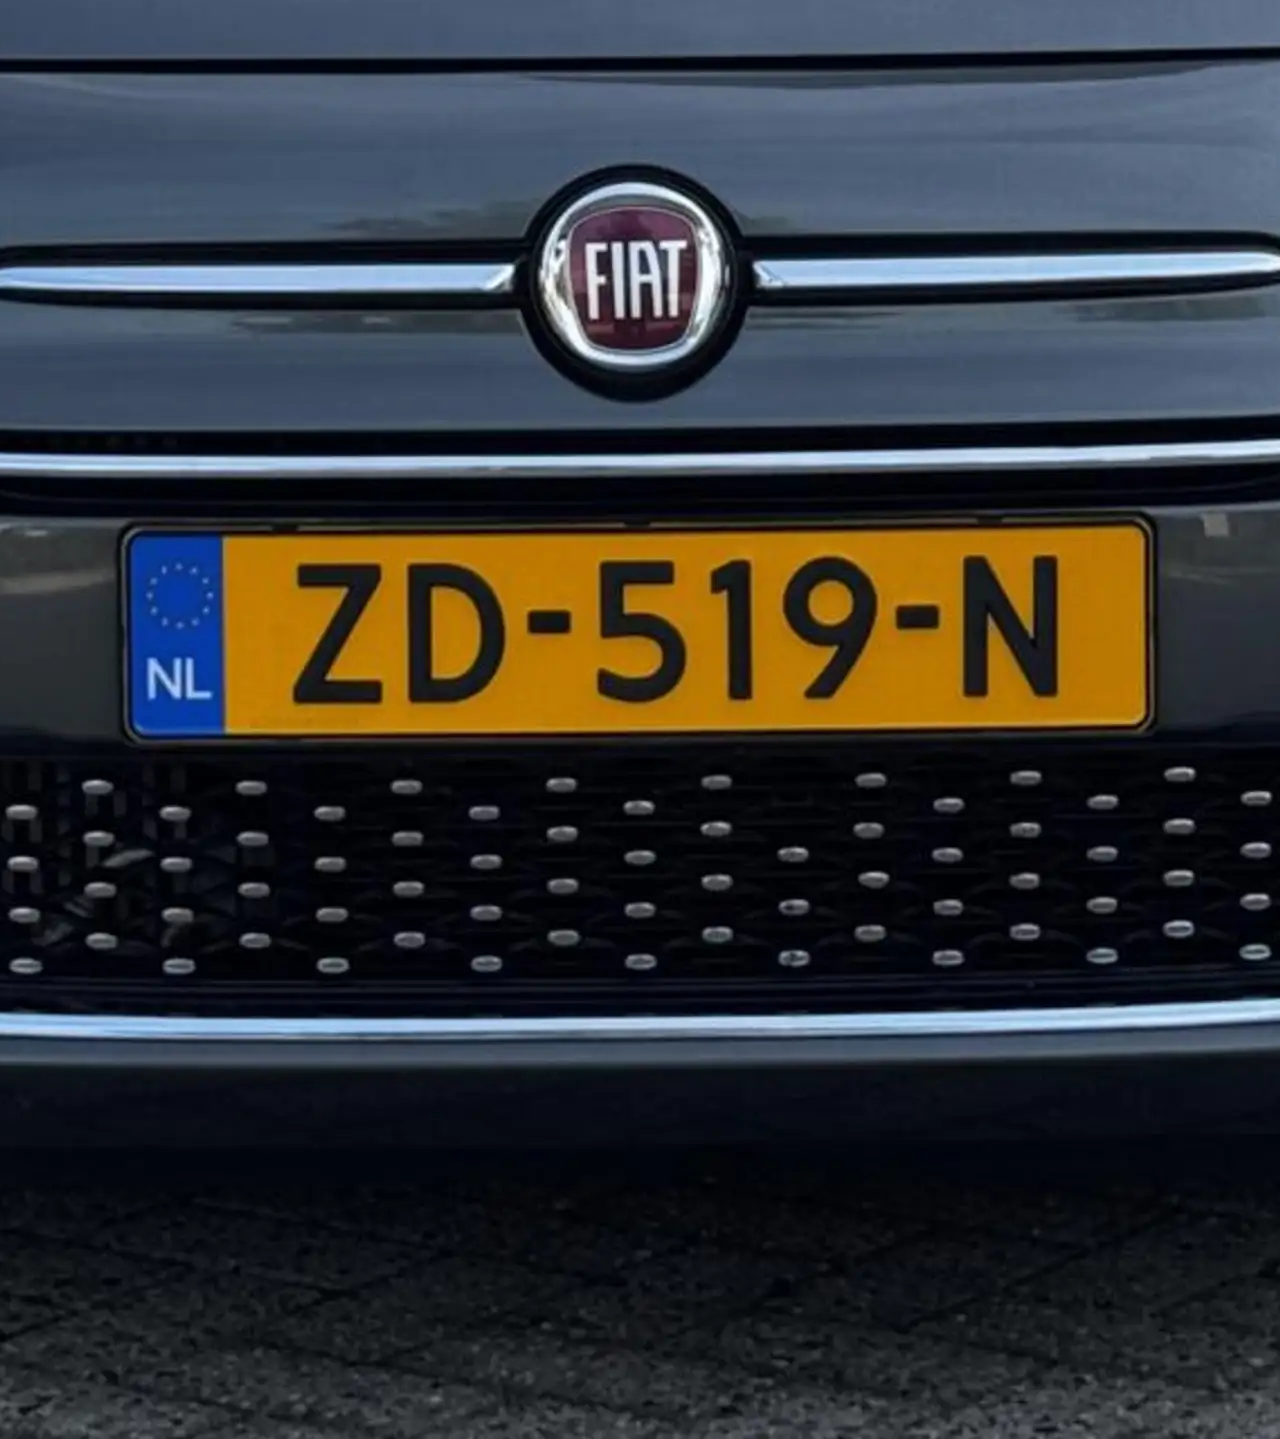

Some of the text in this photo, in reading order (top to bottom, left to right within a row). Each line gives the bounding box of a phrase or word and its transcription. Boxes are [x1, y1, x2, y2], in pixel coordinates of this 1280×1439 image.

[585, 239, 687, 320] FIAT
[292, 555, 1060, 705] ZD-519-N
[146, 657, 213, 700] NL
